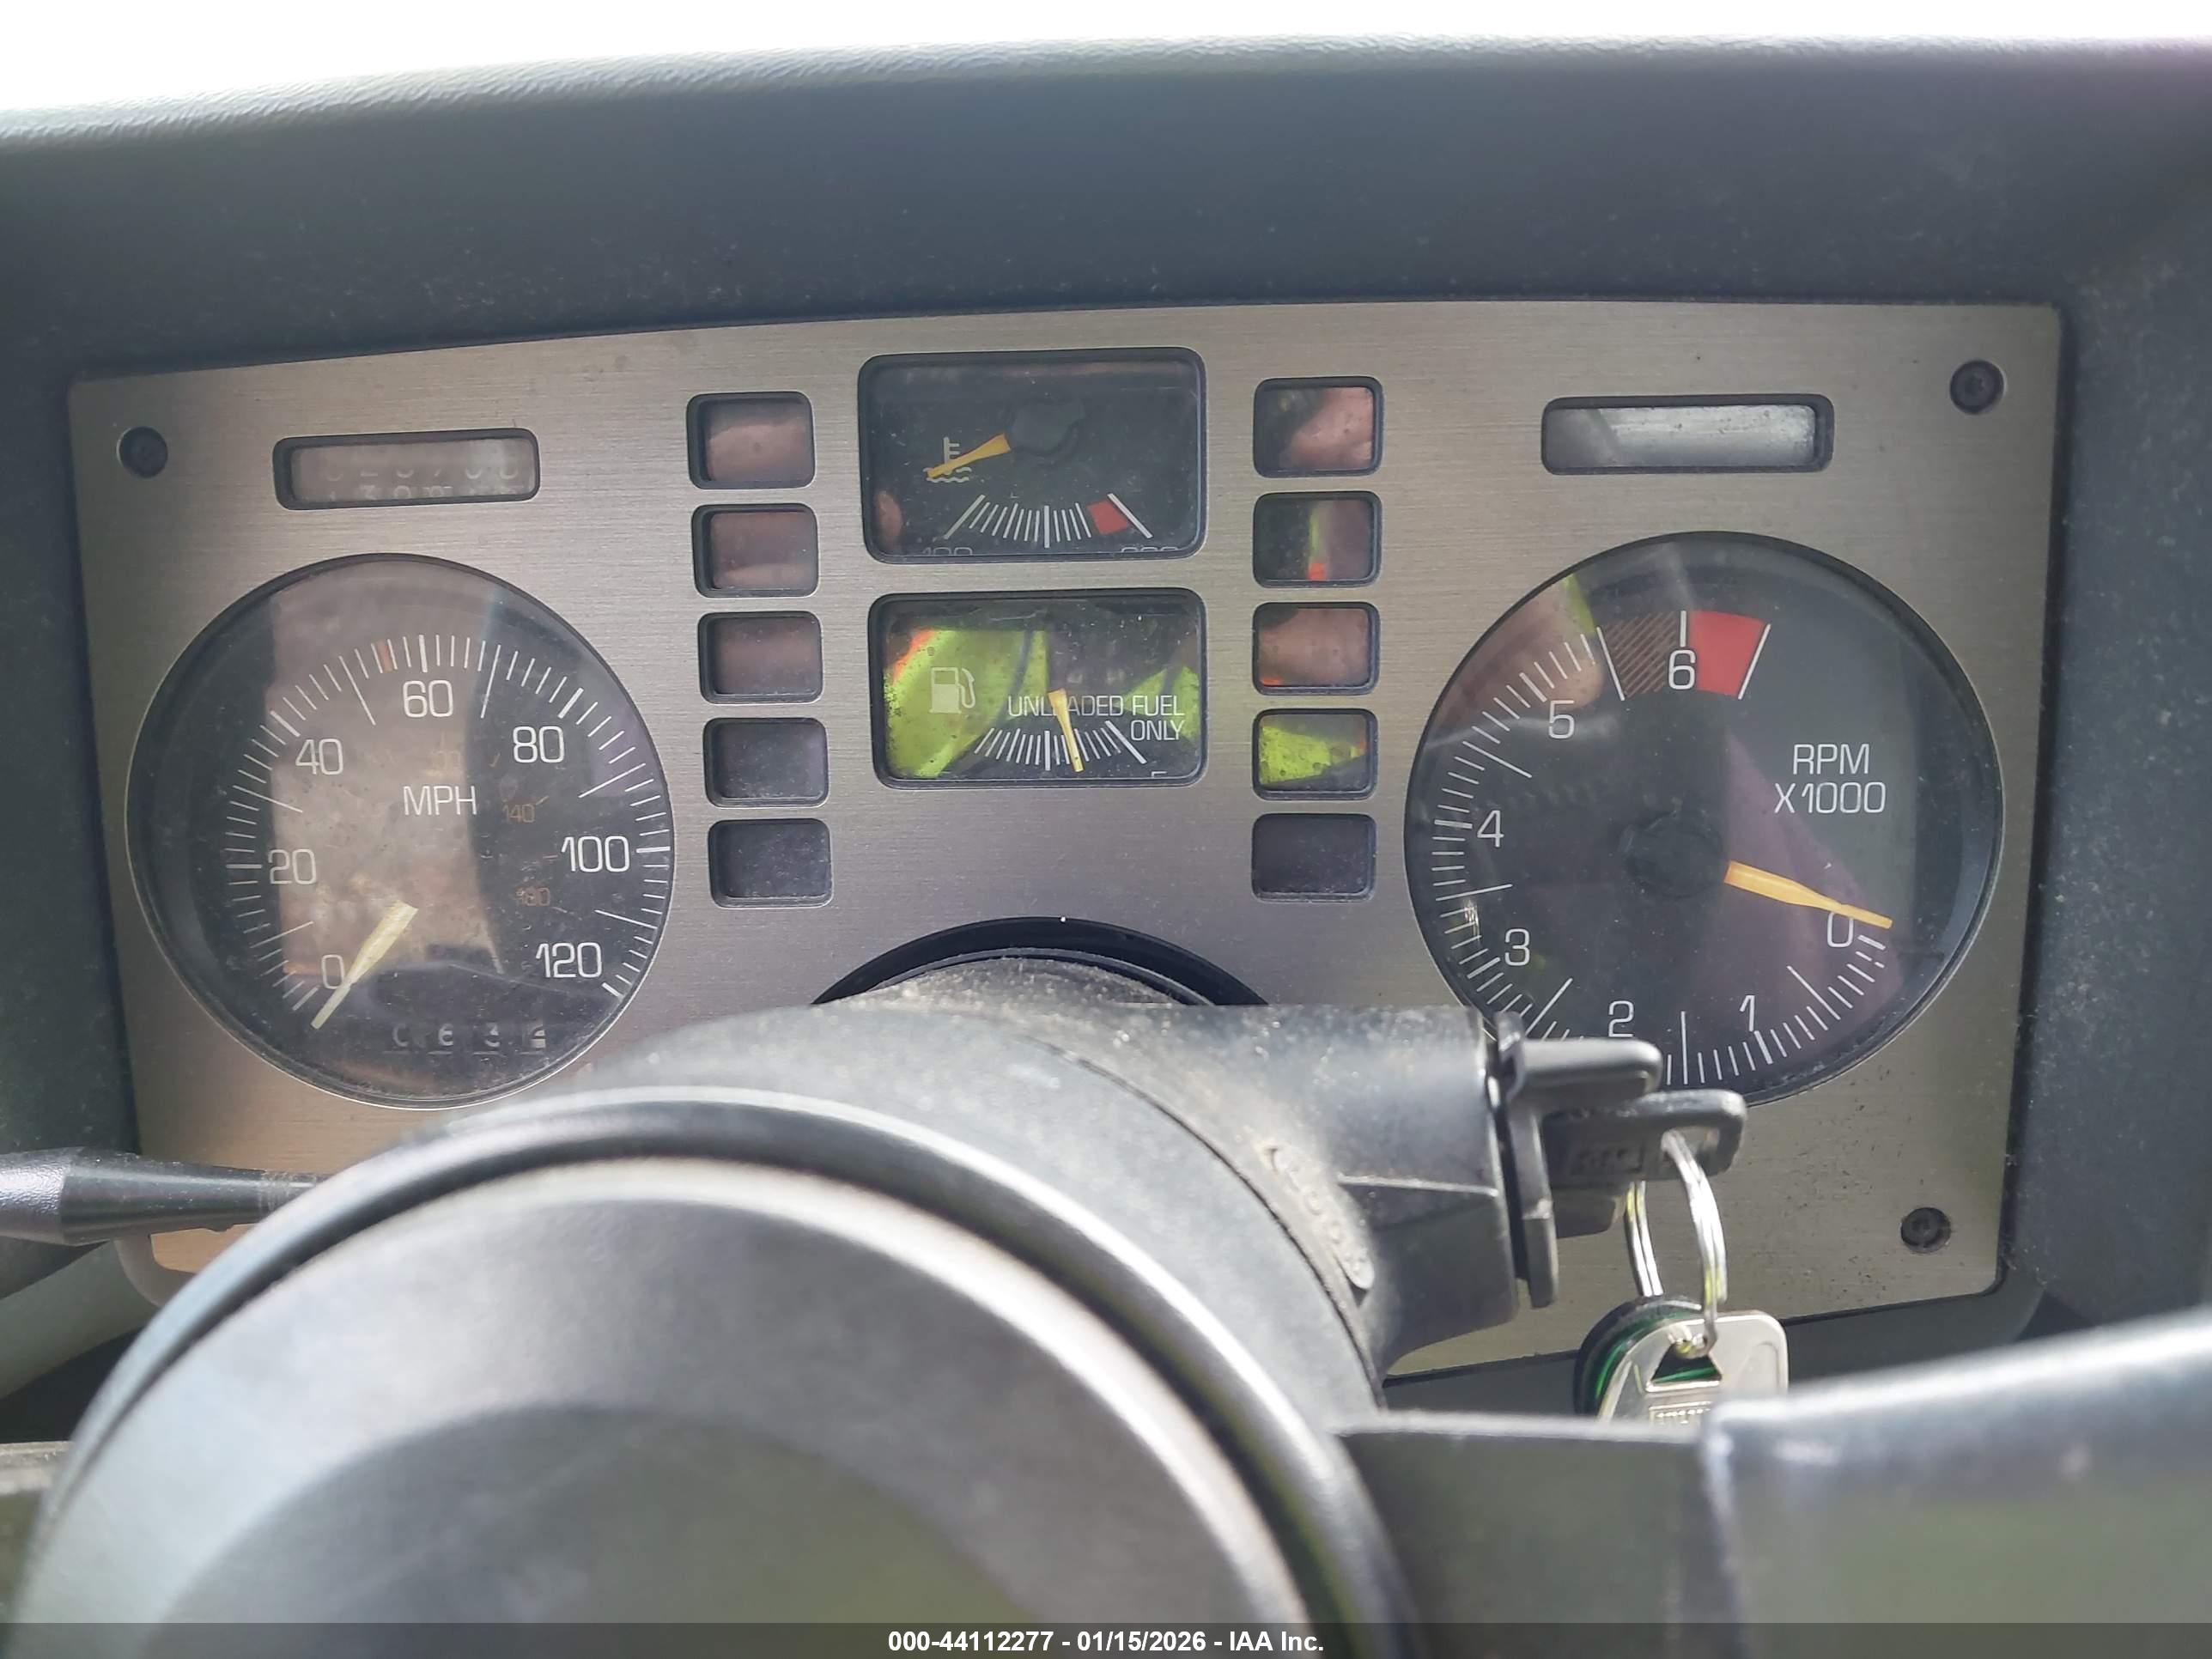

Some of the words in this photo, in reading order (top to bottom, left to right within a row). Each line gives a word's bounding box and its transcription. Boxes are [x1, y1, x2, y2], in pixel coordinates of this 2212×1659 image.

[1668, 649, 1697, 690] 6
[402, 679, 454, 718] 60
[1007, 694, 1124, 718] UNLADED
[1131, 694, 1185, 717] FUEL
[1129, 720, 1185, 742] ONLY
[1547, 699, 1575, 739] 5
[295, 738, 344, 775] 40
[513, 726, 565, 763] 80
[1792, 743, 1870, 775] RPM
[403, 785, 477, 816] MPH
[1476, 810, 1504, 848] 4
[268, 848, 317, 885] 20
[561, 836, 630, 872] 100
[1504, 928, 1531, 966] 3
[1826, 910, 1855, 948] 0
[321, 954, 343, 990] 0
[535, 942, 602, 978] 120
[1607, 1000, 1635, 1037] 2
[1738, 994, 1756, 1032] 1
